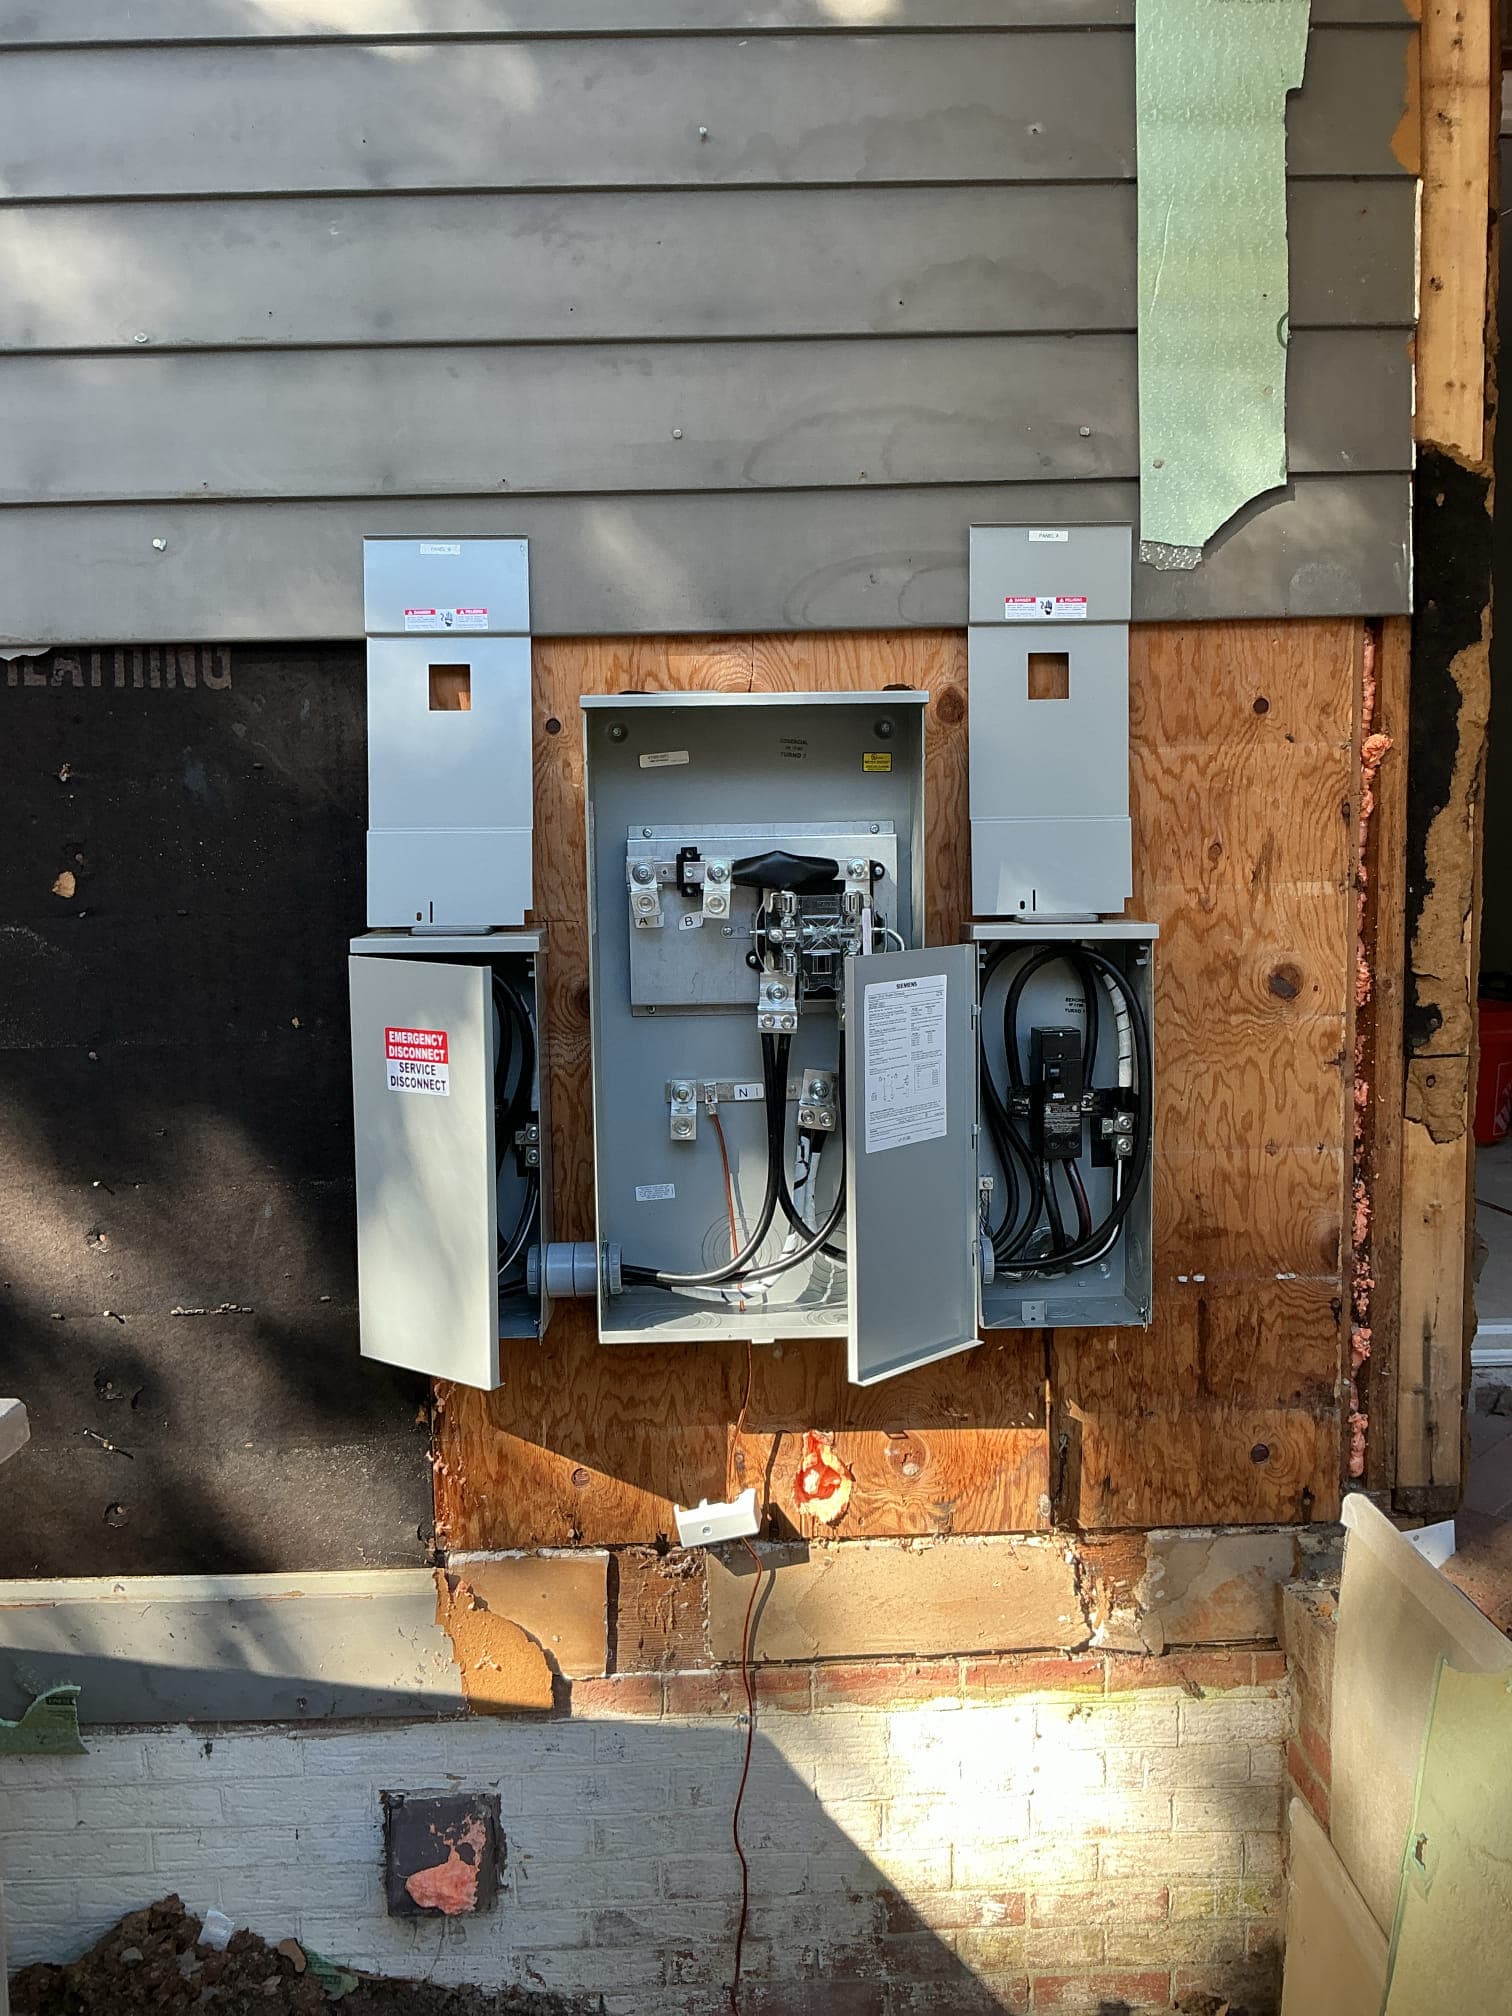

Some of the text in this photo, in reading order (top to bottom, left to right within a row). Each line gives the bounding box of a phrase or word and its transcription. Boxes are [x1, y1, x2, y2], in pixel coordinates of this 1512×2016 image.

[639, 917, 648, 926] A
[684, 916, 694, 927] B
[389, 1031, 443, 1046] EMERGENCY
[389, 1045, 446, 1062] DISCONNECT
[399, 1062, 436, 1076] SERVICE
[390, 1075, 446, 1091] DISCONNECT
[739, 1088, 748, 1097] N
